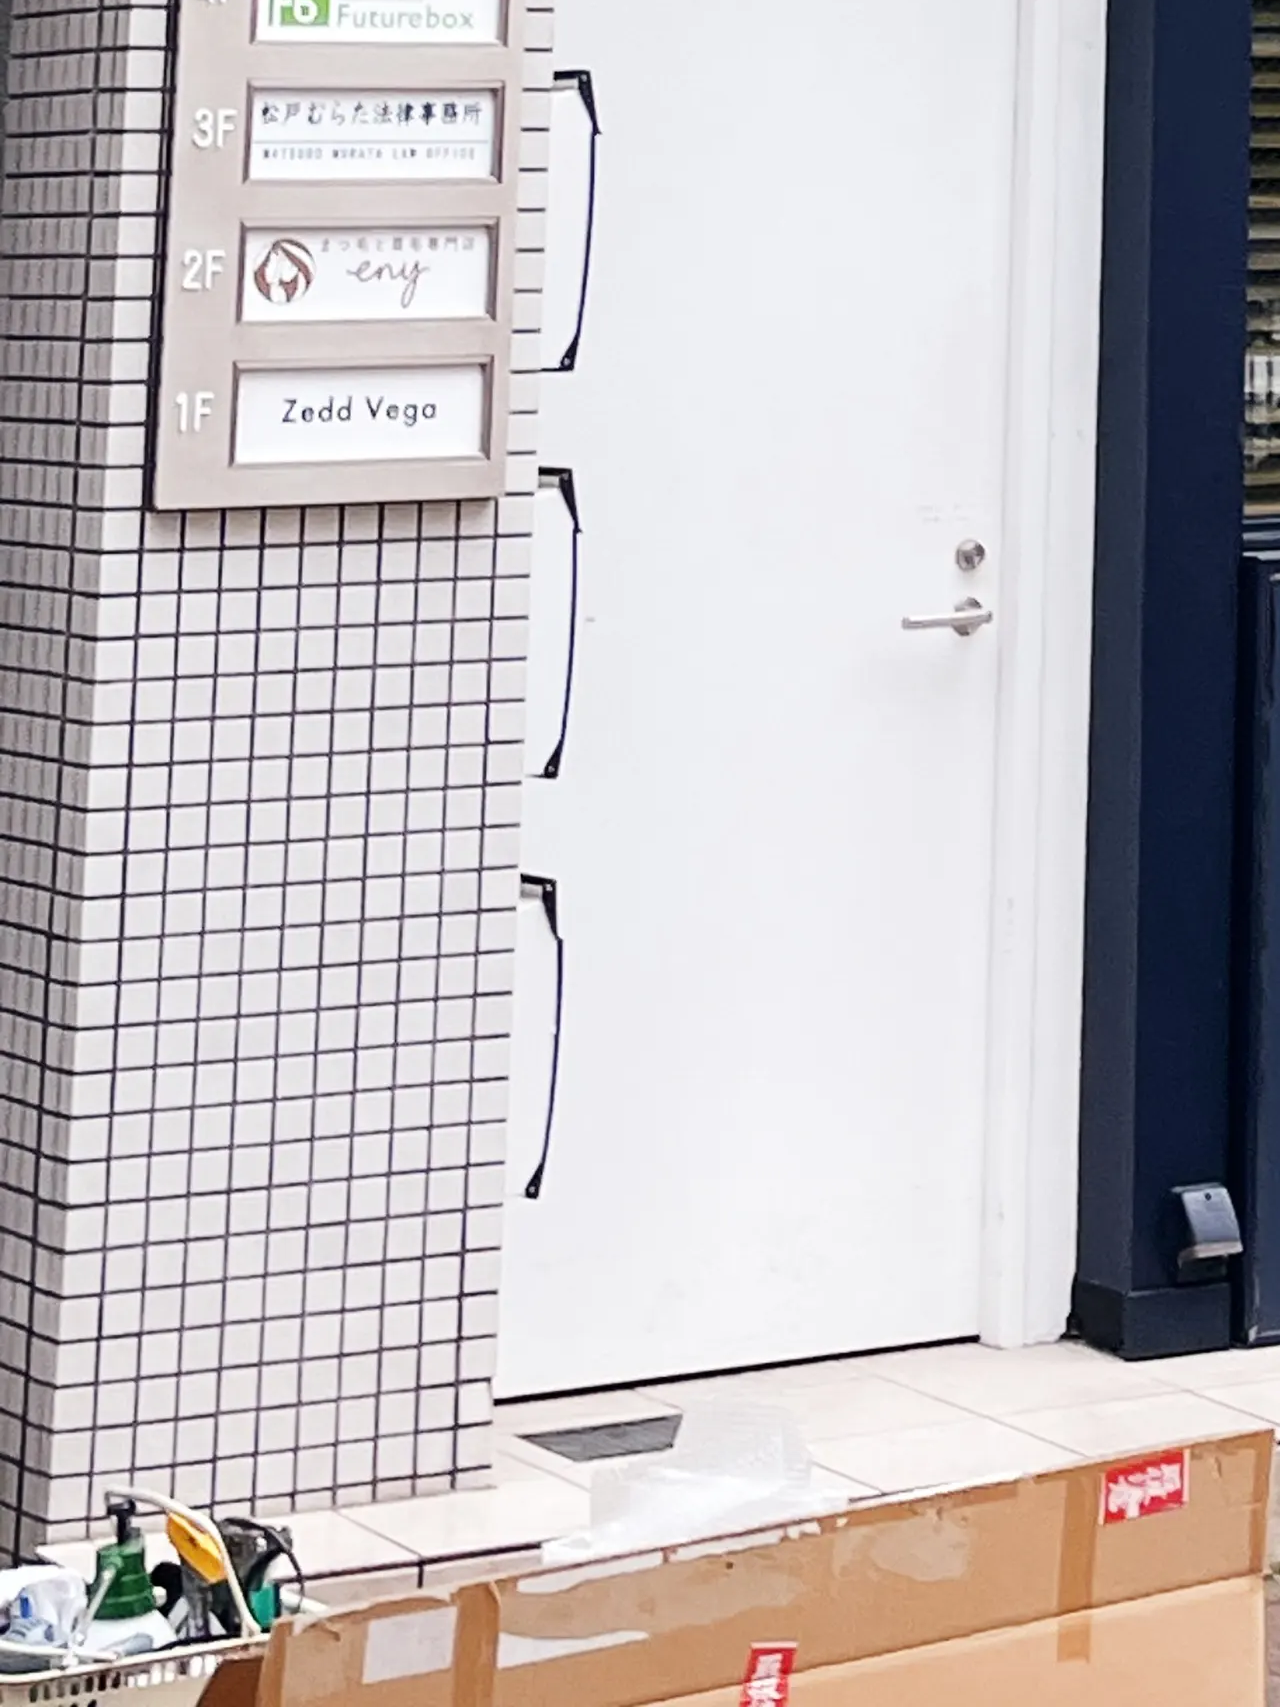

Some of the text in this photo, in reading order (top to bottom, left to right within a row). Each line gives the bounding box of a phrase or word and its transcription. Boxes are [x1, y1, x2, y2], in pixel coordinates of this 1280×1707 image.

[336, 3, 474, 29] Futurebox
[192, 108, 238, 148] 3F
[181, 248, 226, 290] 2F
[346, 259, 430, 309] eny
[175, 391, 215, 434] 1F
[281, 395, 437, 426] Zedd Vega
